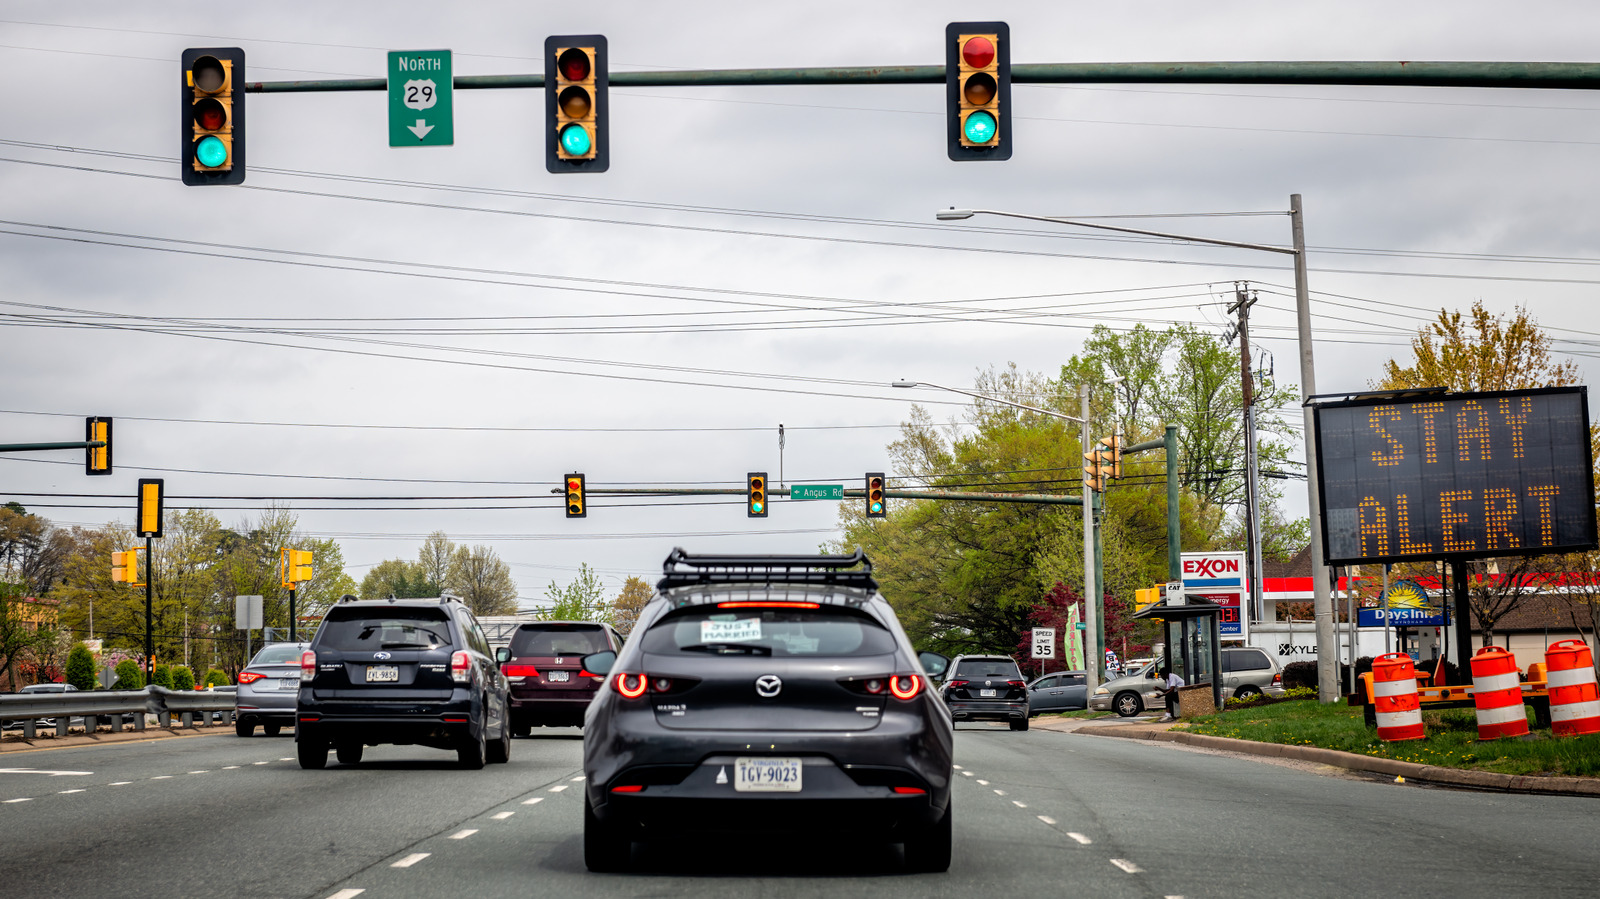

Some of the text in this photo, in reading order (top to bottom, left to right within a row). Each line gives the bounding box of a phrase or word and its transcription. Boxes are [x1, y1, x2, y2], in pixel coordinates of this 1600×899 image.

[399, 56, 441, 71] NORTH
[408, 86, 432, 102] 29
[1368, 397, 1533, 466] STAY
[804, 488, 842, 498] Angus Rd
[1358, 484, 1561, 557] ALERT
[1183, 558, 1239, 578] EXXON
[1375, 609, 1409, 620] Days
[711, 622, 753, 630] JUST
[704, 630, 759, 639] MARRIED
[1035, 645, 1051, 655] 35
[740, 766, 798, 783] TGV-9023
